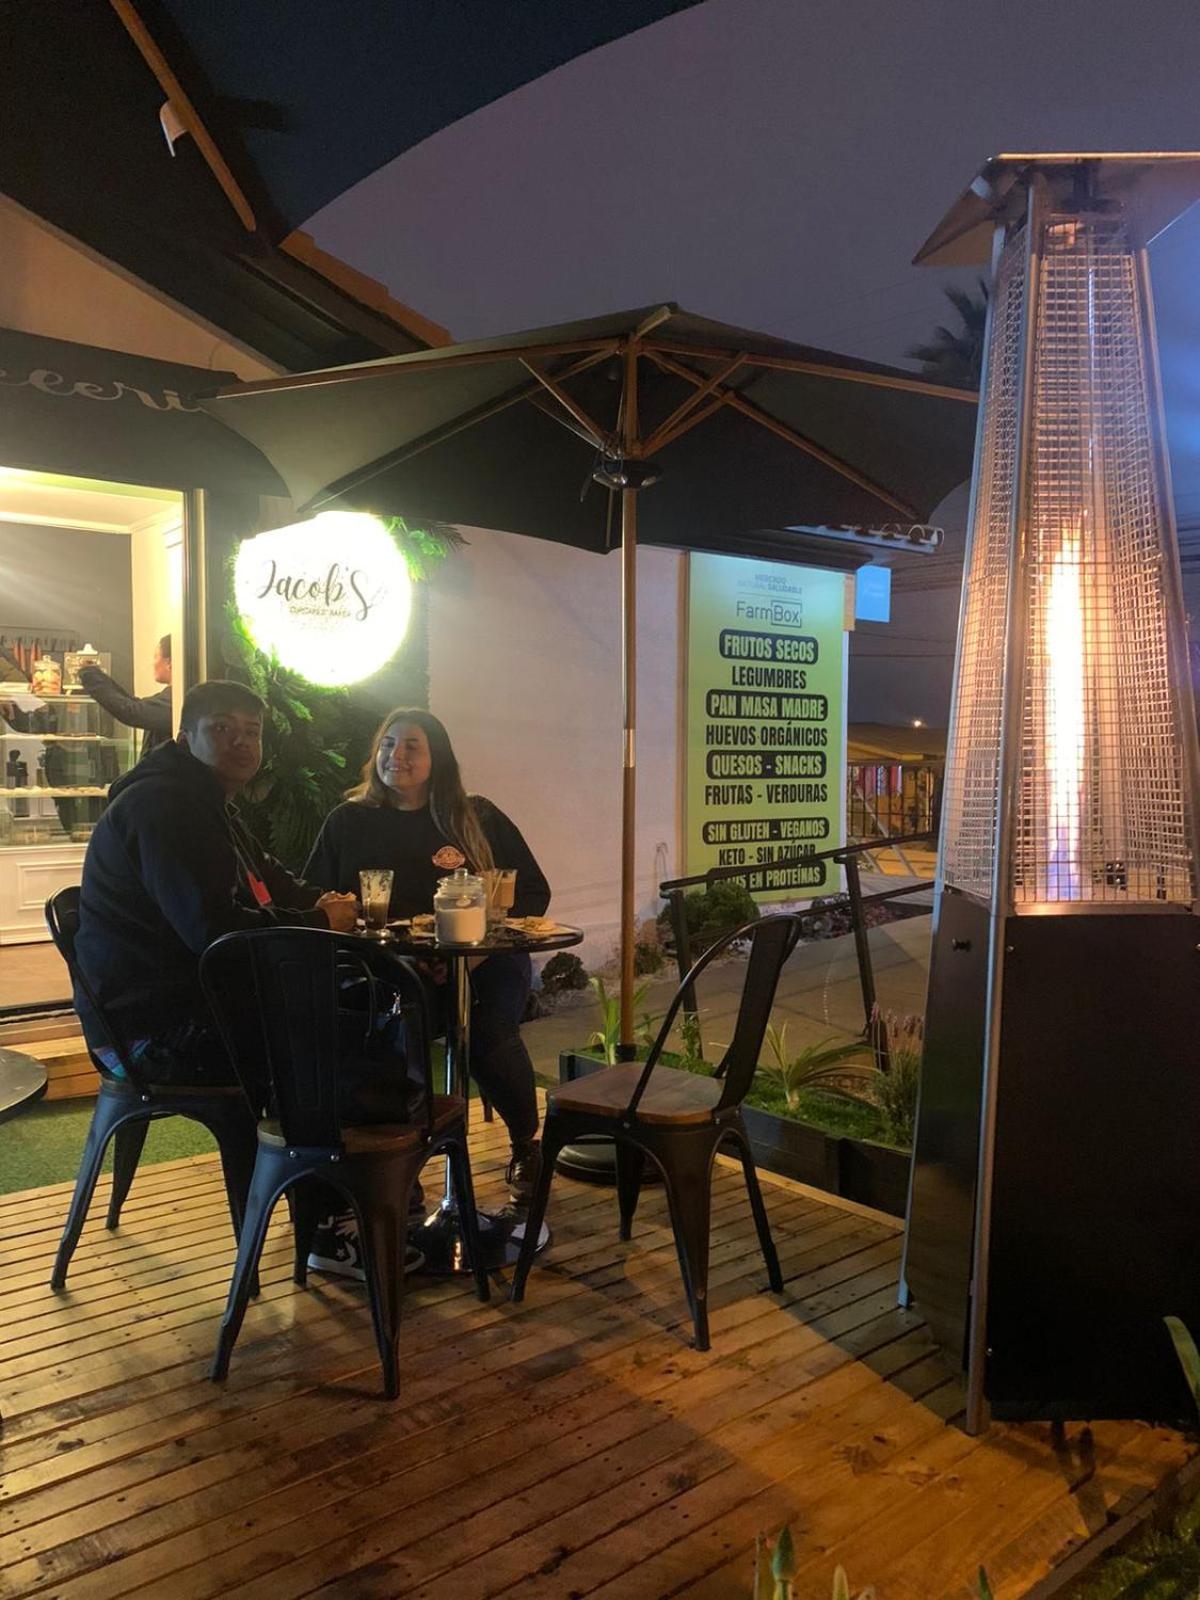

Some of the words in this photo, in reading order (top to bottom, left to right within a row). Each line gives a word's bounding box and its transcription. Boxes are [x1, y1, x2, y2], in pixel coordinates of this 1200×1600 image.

[736, 600, 800, 623] FarmBox
[724, 634, 772, 660] FRUTOS
[776, 639, 814, 661] SECOS
[732, 665, 807, 689] LEGUMBRES
[711, 694, 736, 715] PAN
[741, 696, 778, 717] MASA
[781, 698, 824, 719] MADRE
[706, 725, 756, 746] HUEVOS
[760, 721, 828, 746] ORGÁNICOS
[712, 756, 763, 777] QUESOS
[775, 755, 822, 776] SNACKS
[705, 784, 753, 806] FRUTAS
[766, 783, 828, 805] VERDURAS
[707, 824, 727, 842] SIN
[730, 822, 770, 841] GLUTEN
[780, 820, 826, 838] VEGANOS
[719, 848, 746, 866] KETO
[756, 846, 774, 864] SIN
[749, 871, 763, 888] EN
[766, 863, 820, 888] PROTEÍNAS
